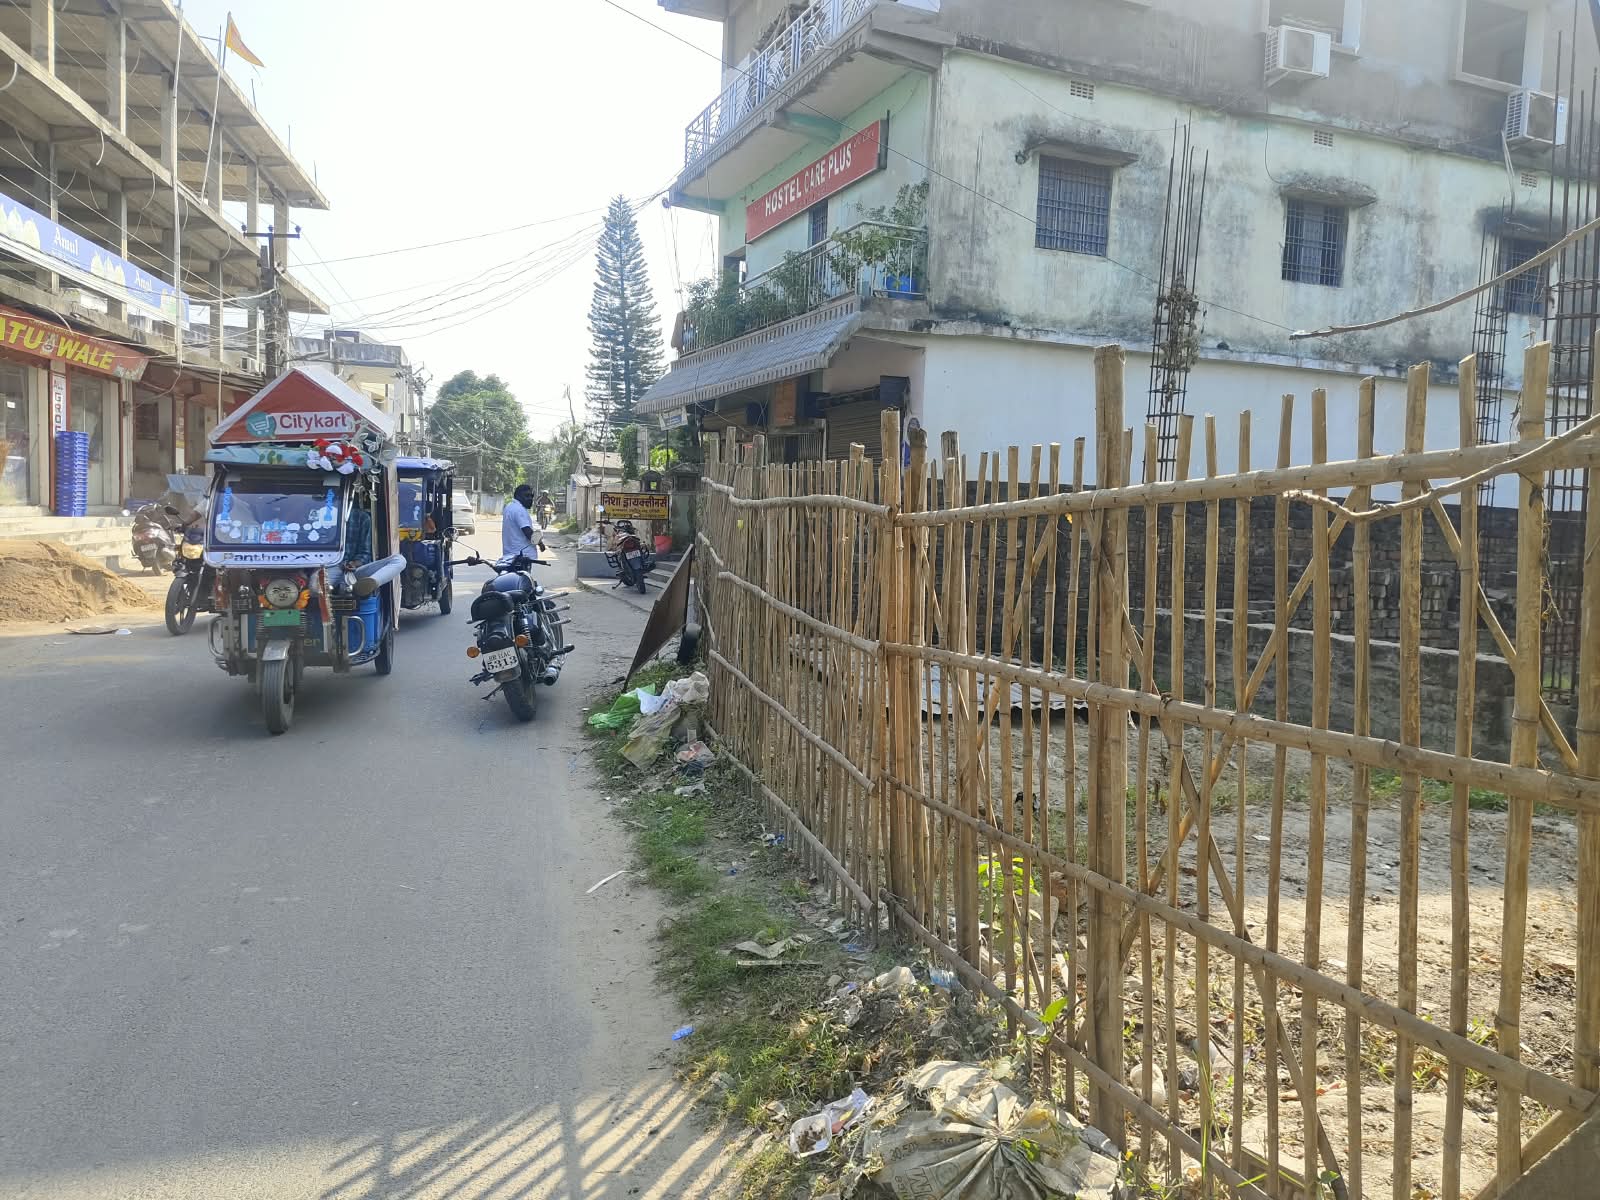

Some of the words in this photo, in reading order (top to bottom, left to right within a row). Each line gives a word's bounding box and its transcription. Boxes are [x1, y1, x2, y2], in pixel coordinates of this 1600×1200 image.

[765, 177, 802, 216] HOSTEL
[804, 160, 826, 192] CARE
[828, 143, 852, 179] PLUS
[53, 227, 79, 256] Amul
[135, 270, 153, 292] Amul
[56, 336, 116, 370] WALE
[279, 413, 348, 432] Citykart
[602, 494, 620, 506] निशा
[223, 553, 288, 562] Panther
[487, 655, 518, 670] 5313
